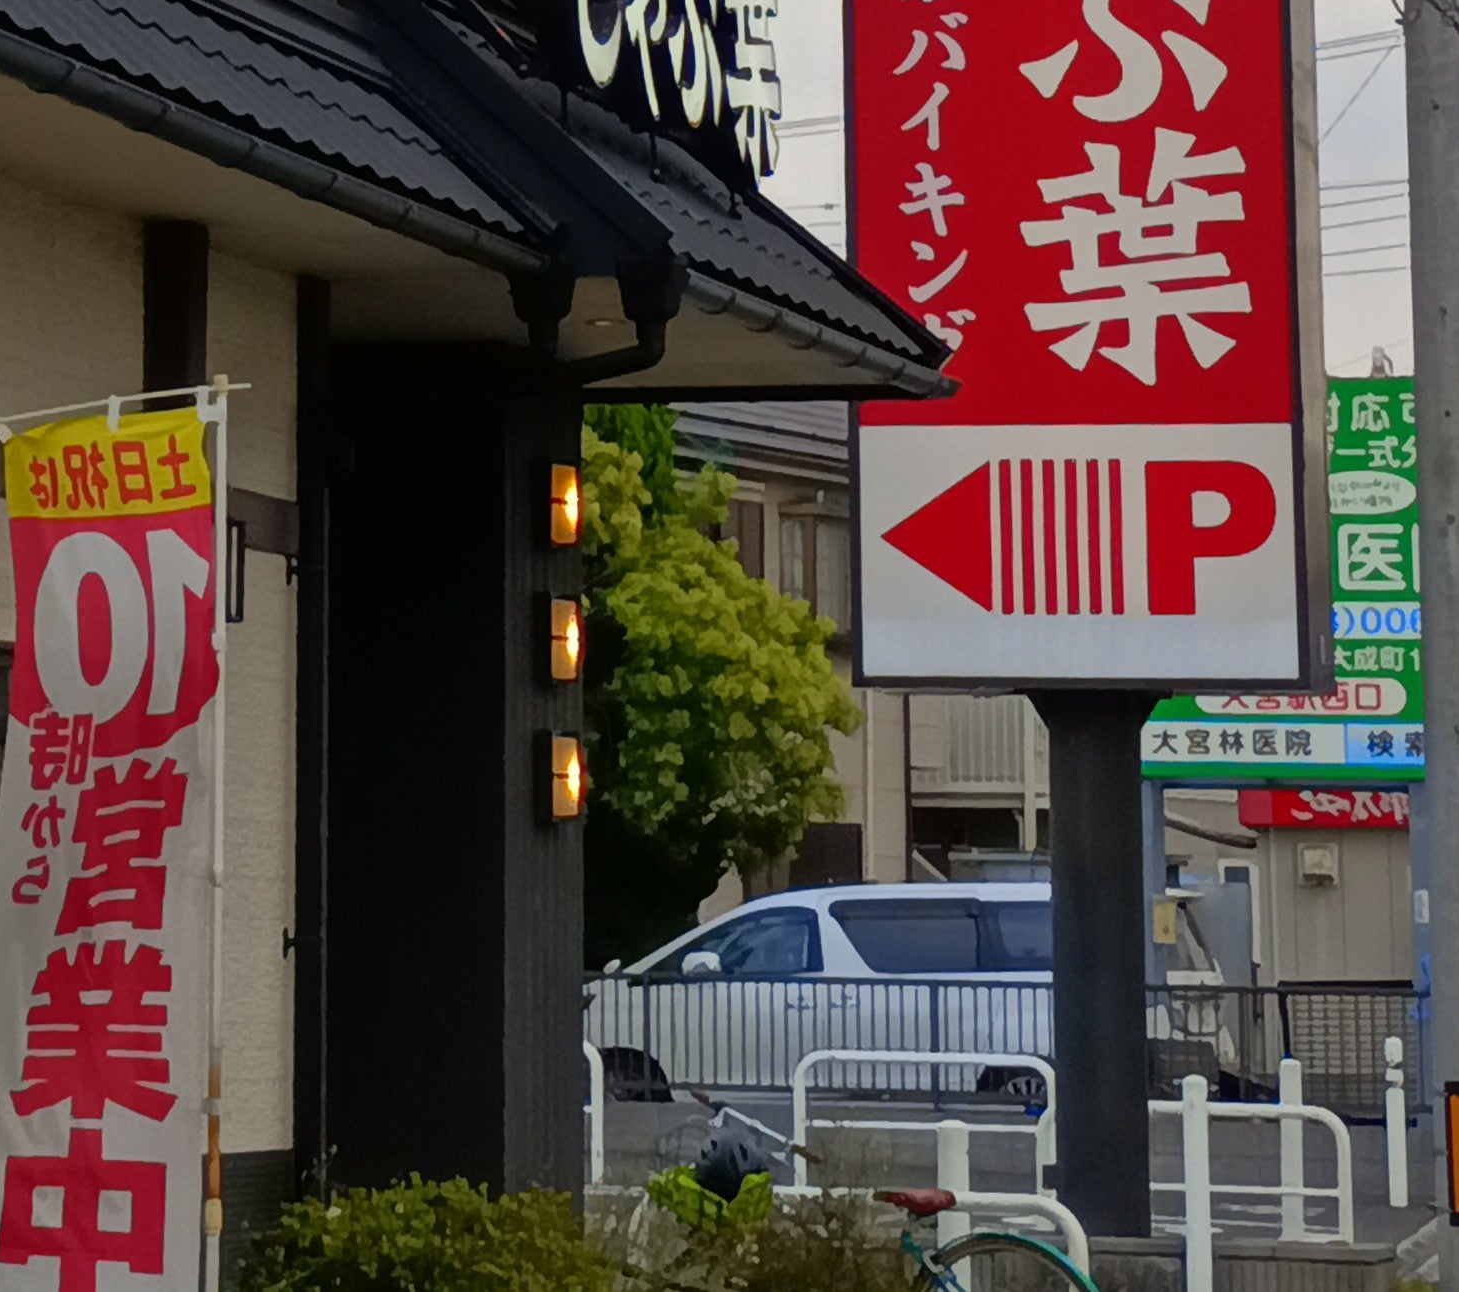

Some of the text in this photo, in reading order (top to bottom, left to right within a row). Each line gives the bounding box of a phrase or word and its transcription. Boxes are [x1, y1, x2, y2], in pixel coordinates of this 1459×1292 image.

[1145, 460, 1277, 616] P
[1338, 523, 1420, 593] 医
[1152, 728, 1313, 757] 大宮林医院
